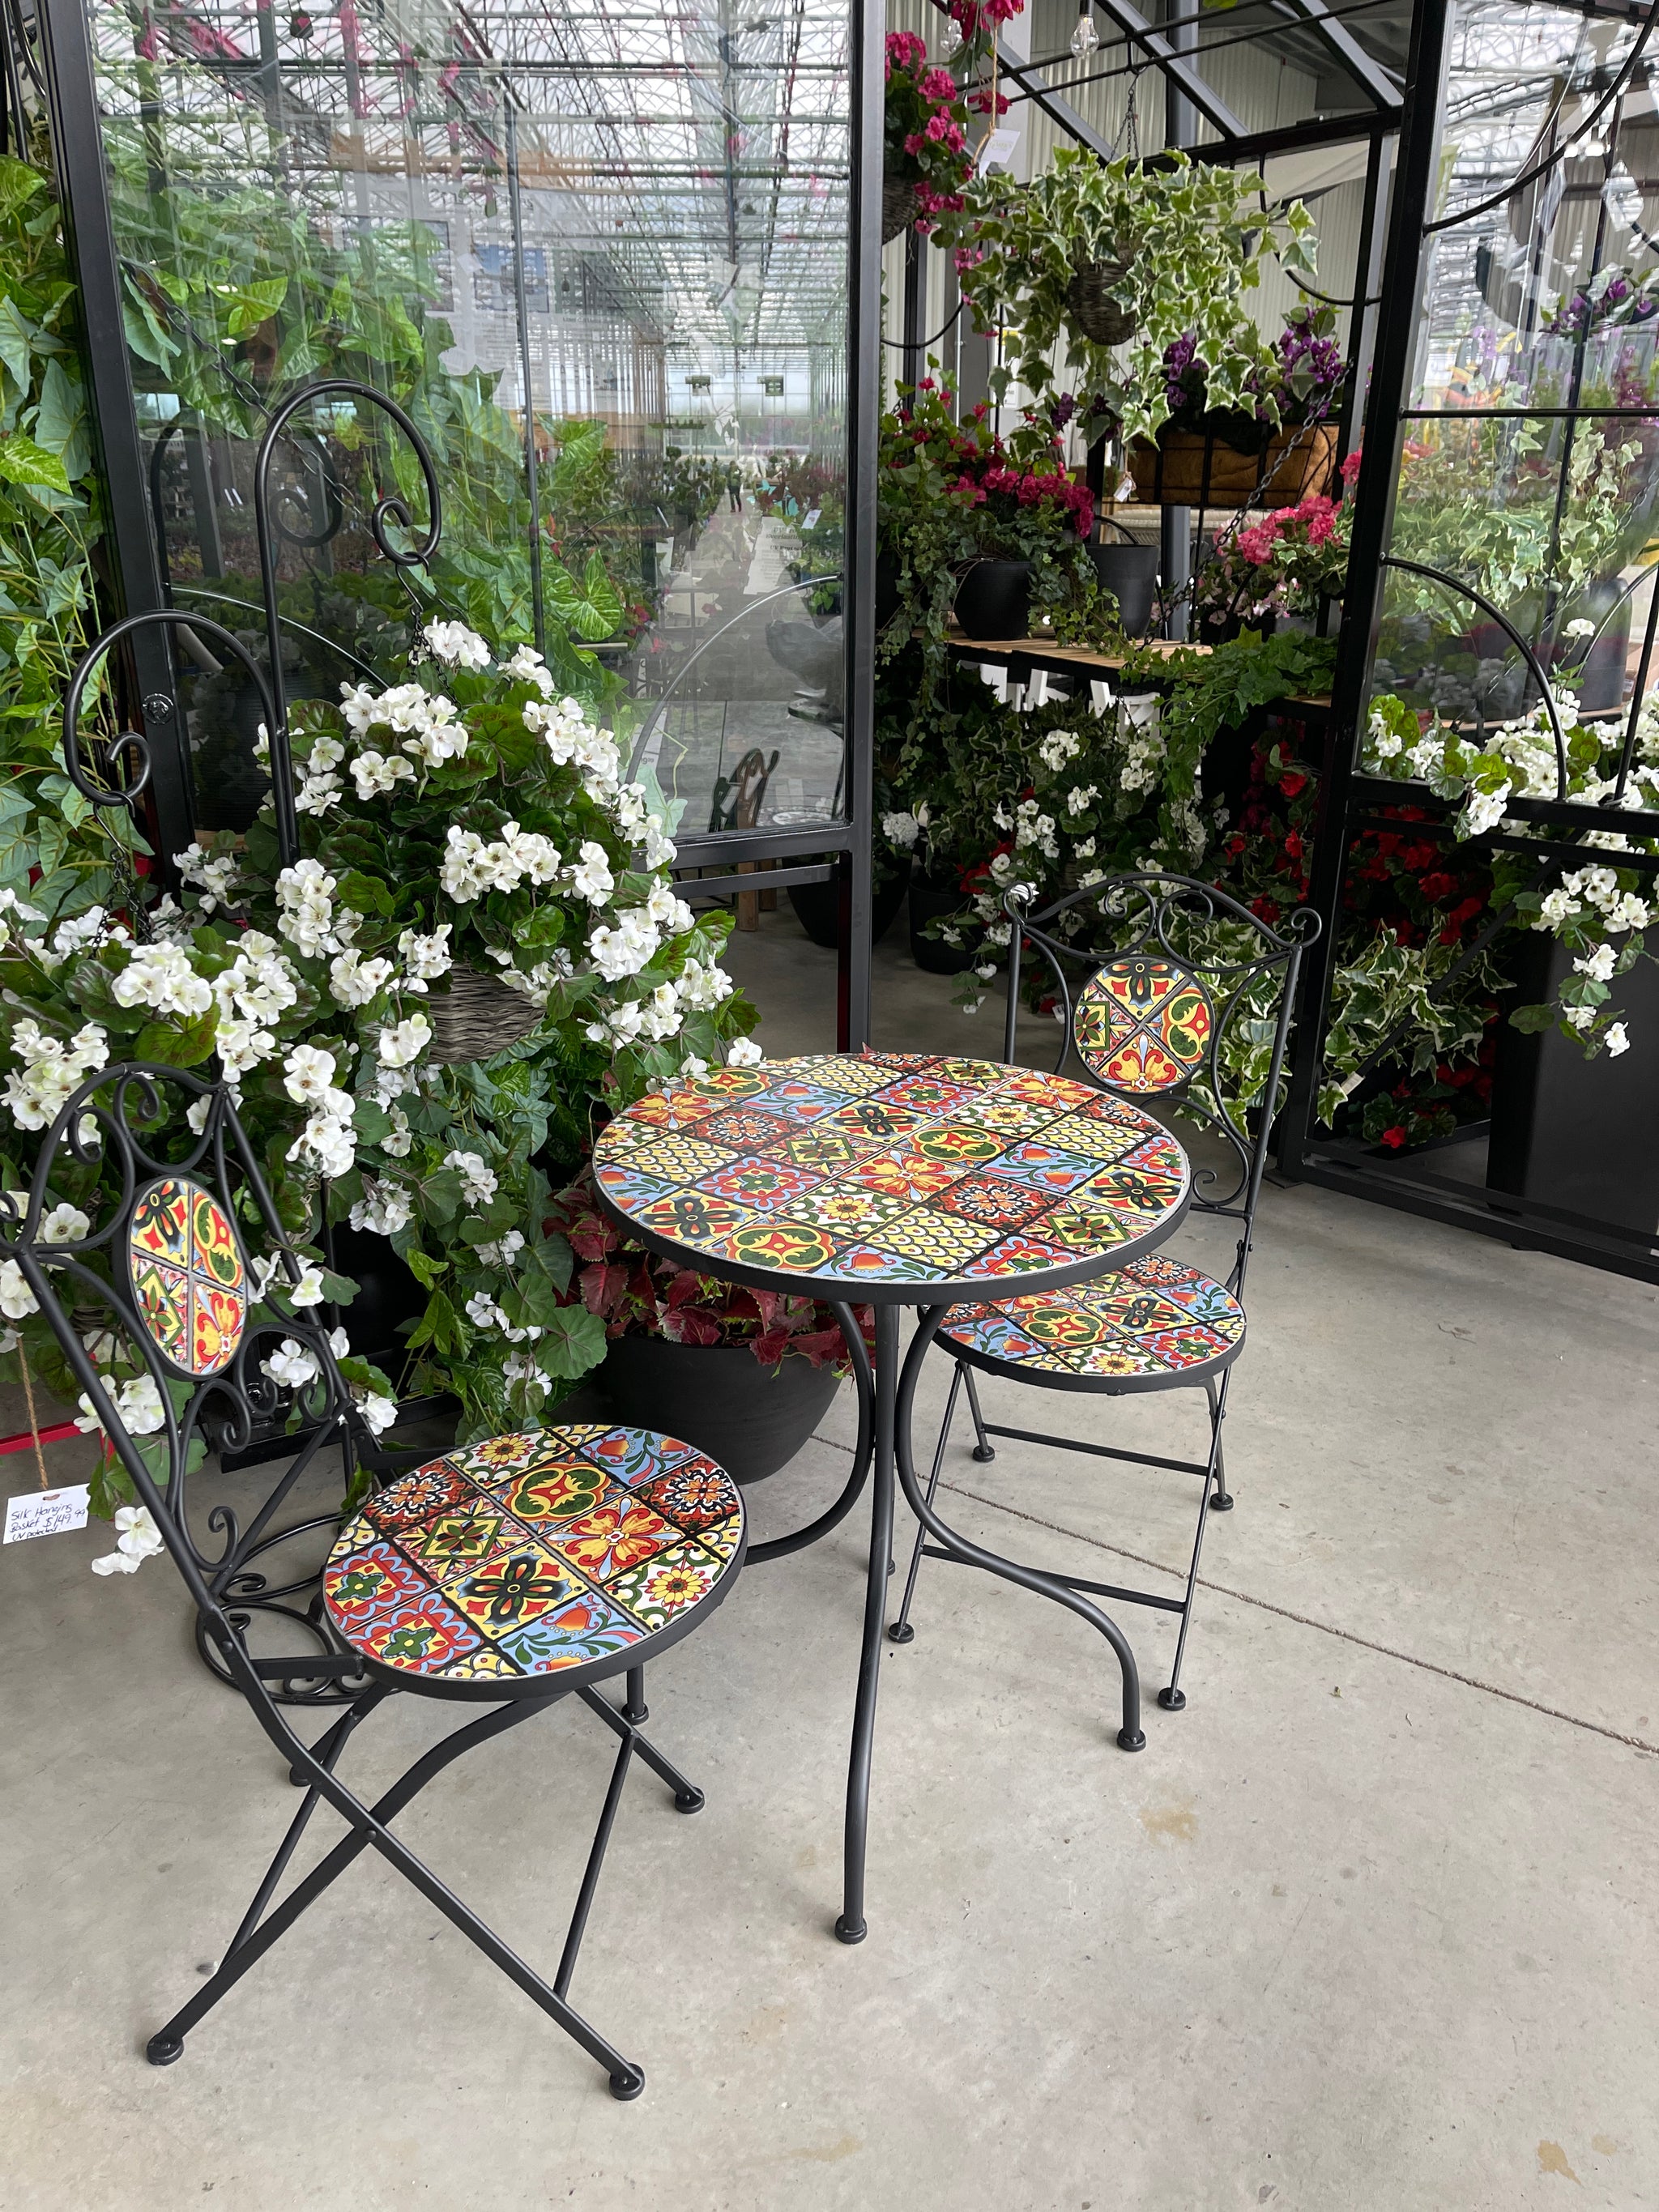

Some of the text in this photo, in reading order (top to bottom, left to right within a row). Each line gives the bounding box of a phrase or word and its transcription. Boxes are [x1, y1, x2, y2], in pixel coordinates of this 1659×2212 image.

[11, 1503, 73, 1521] Silk Hanging
[10, 1517, 40, 1533] Basket
[12, 1532, 26, 1541] UV
